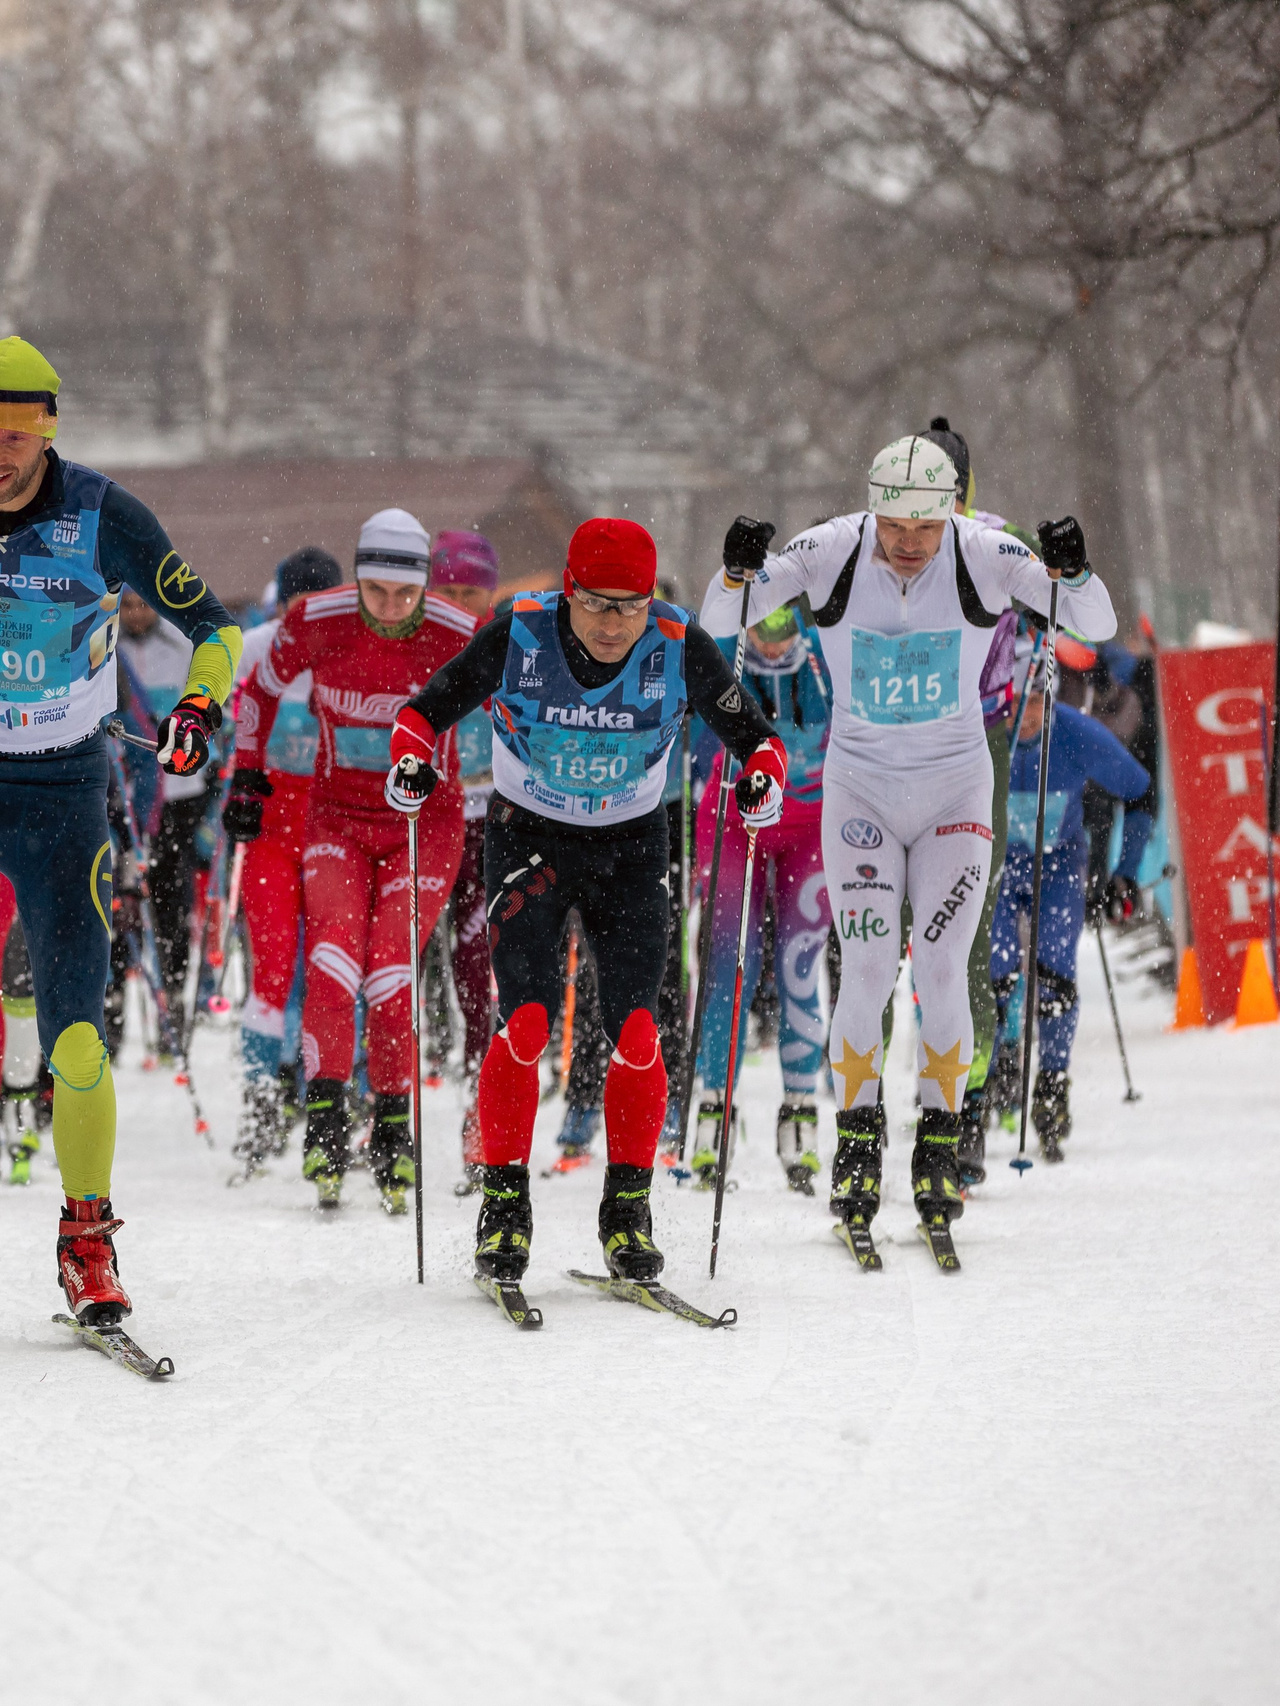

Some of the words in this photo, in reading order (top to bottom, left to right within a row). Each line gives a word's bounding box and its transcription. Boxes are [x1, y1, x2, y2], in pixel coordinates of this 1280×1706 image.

[54, 519, 81, 531] PIONER
[52, 528, 80, 545] CUP
[11, 681, 44, 692] ОБЛАСТЬ
[519, 680, 543, 688] СБР
[870, 672, 942, 706] 1215
[644, 689, 666, 699] CUP
[33, 703, 71, 716] РОДНЫЕ
[545, 704, 635, 729] rukka
[34, 712, 67, 726] ГОРОДА
[550, 754, 628, 784] 1850
[1195, 687, 1280, 962] СТАР
[841, 881, 894, 892] SCANIA
[923, 874, 974, 944] CRAFT
[840, 907, 890, 943] life
[64, 1260, 86, 1295] alpina
